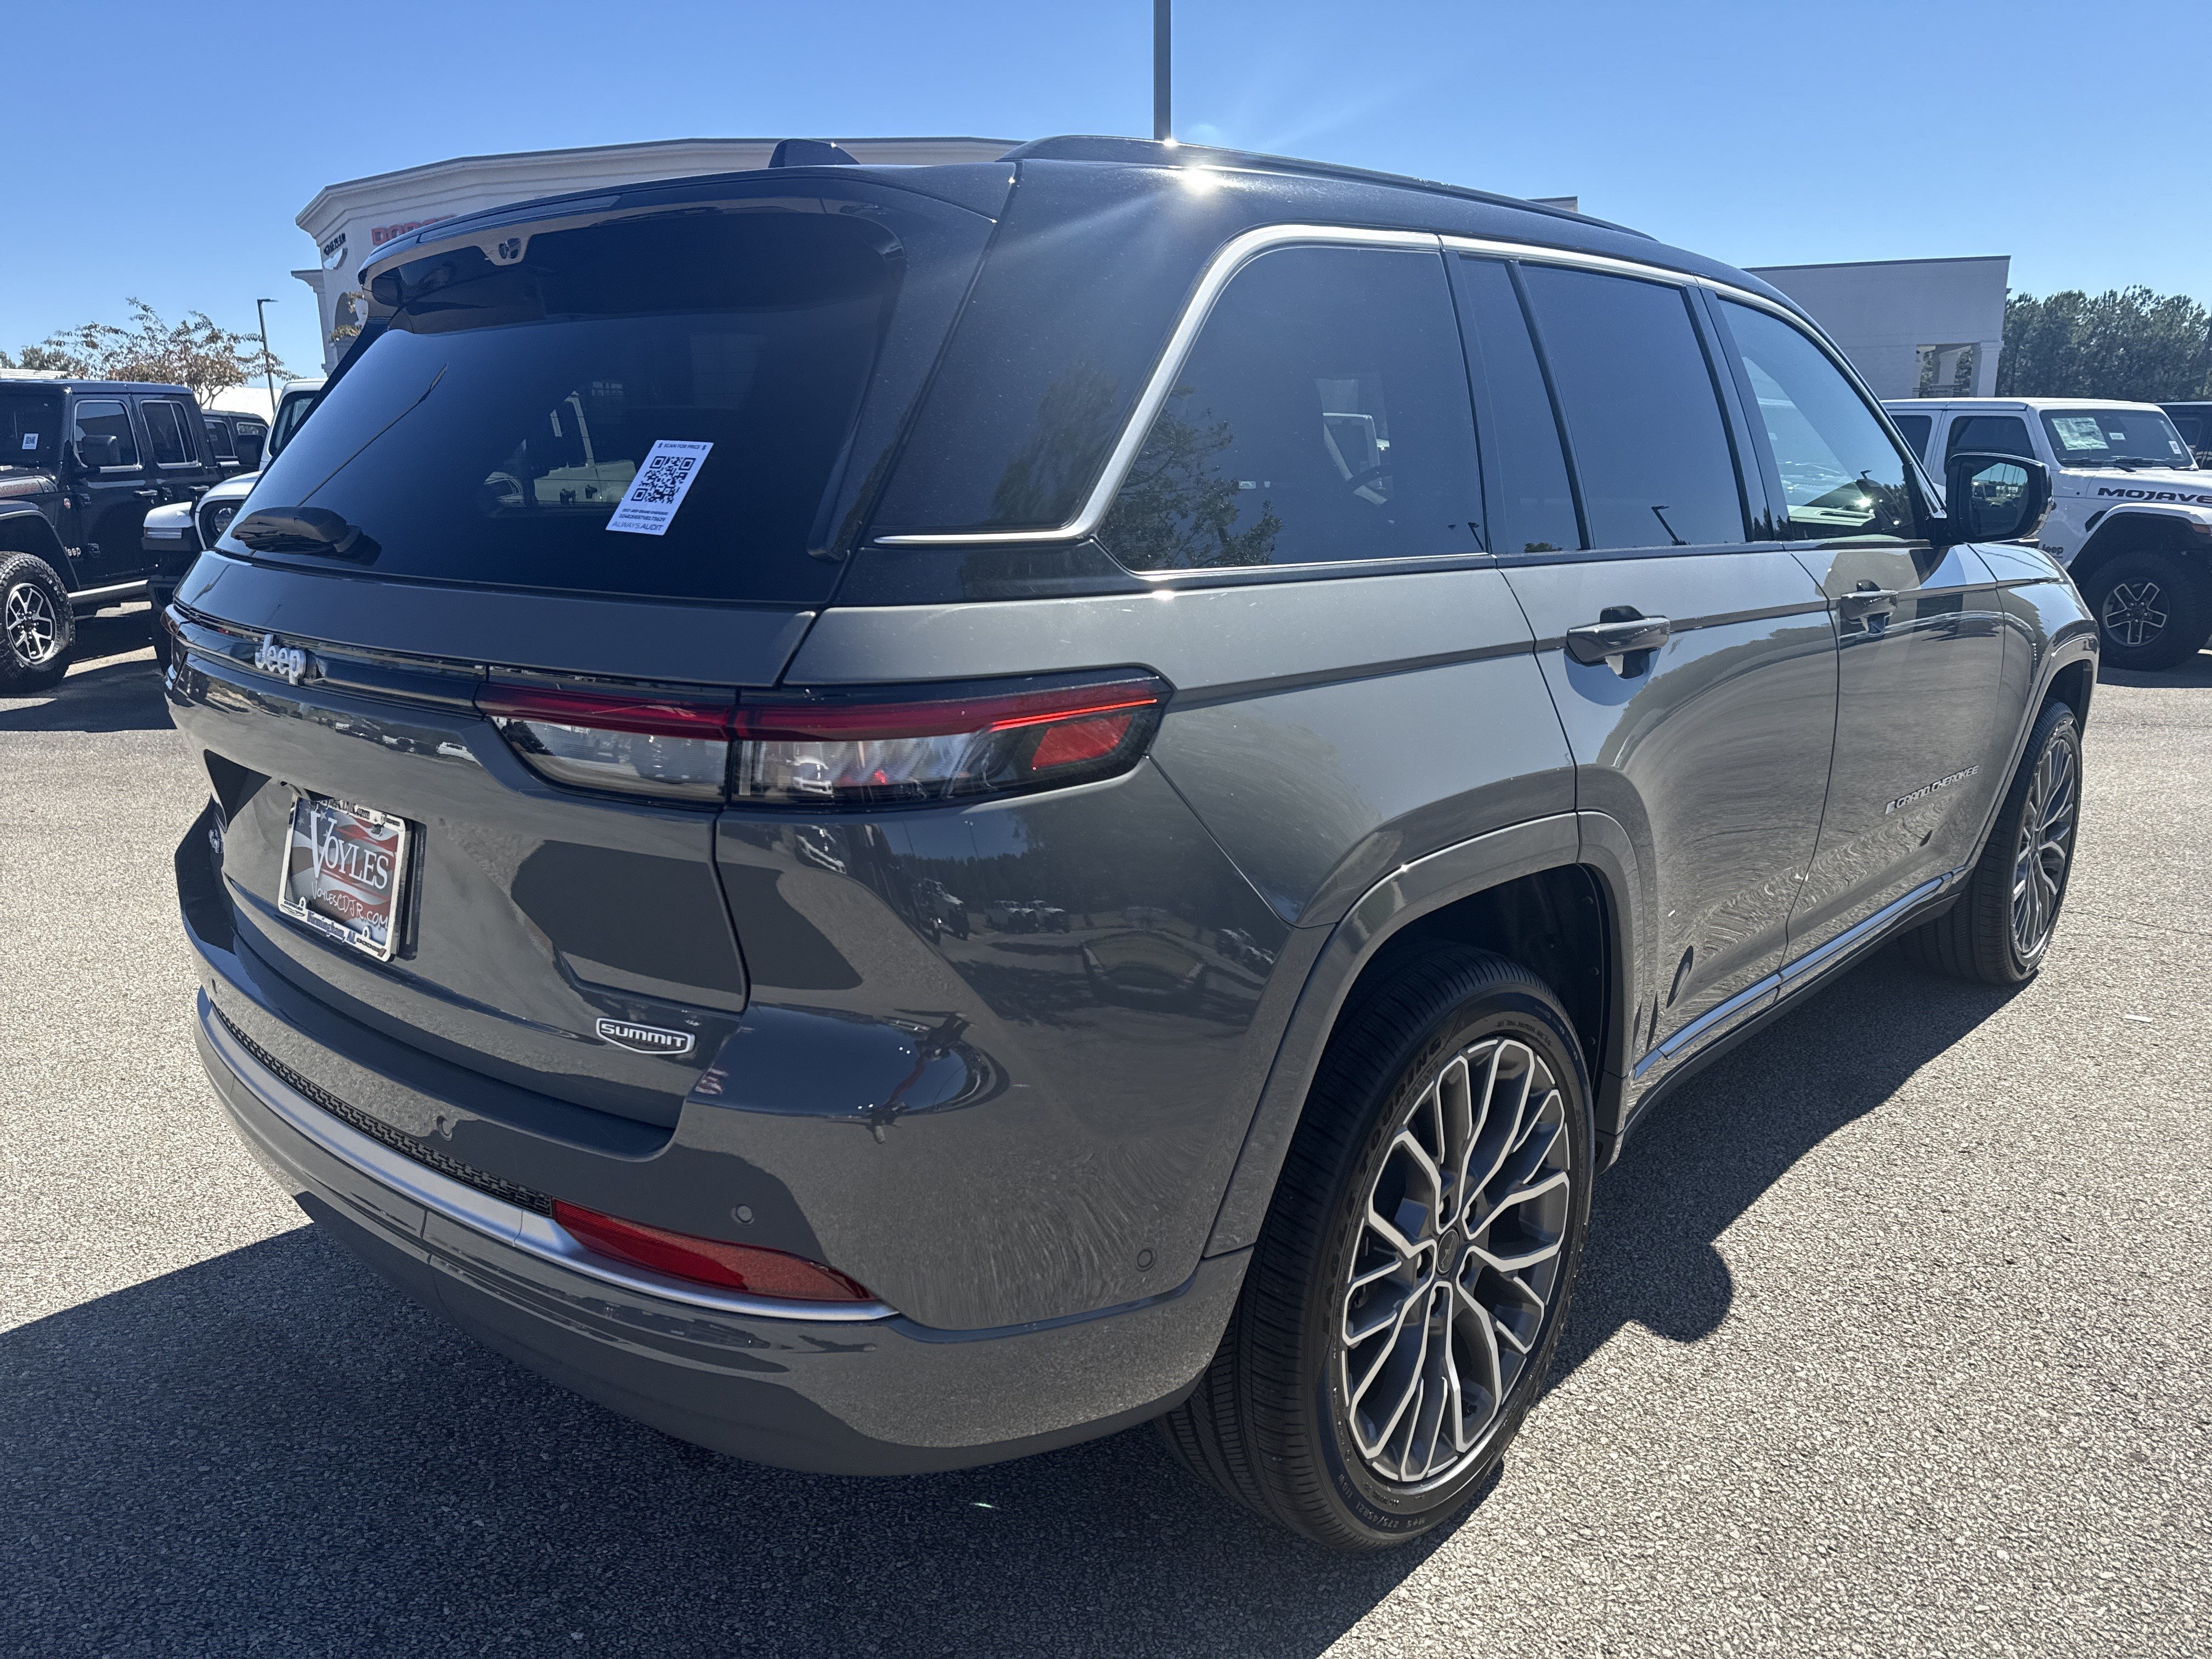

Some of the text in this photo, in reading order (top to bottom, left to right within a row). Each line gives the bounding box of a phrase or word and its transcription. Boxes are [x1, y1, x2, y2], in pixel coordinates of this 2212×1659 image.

[2097, 487, 2212, 504] MOJAVE
[254, 634, 305, 686] Jeep
[1895, 765, 1979, 809] GRAND CHEROKEE
[311, 810, 390, 889] VOYLES
[600, 1023, 686, 1047] SUMMIT
